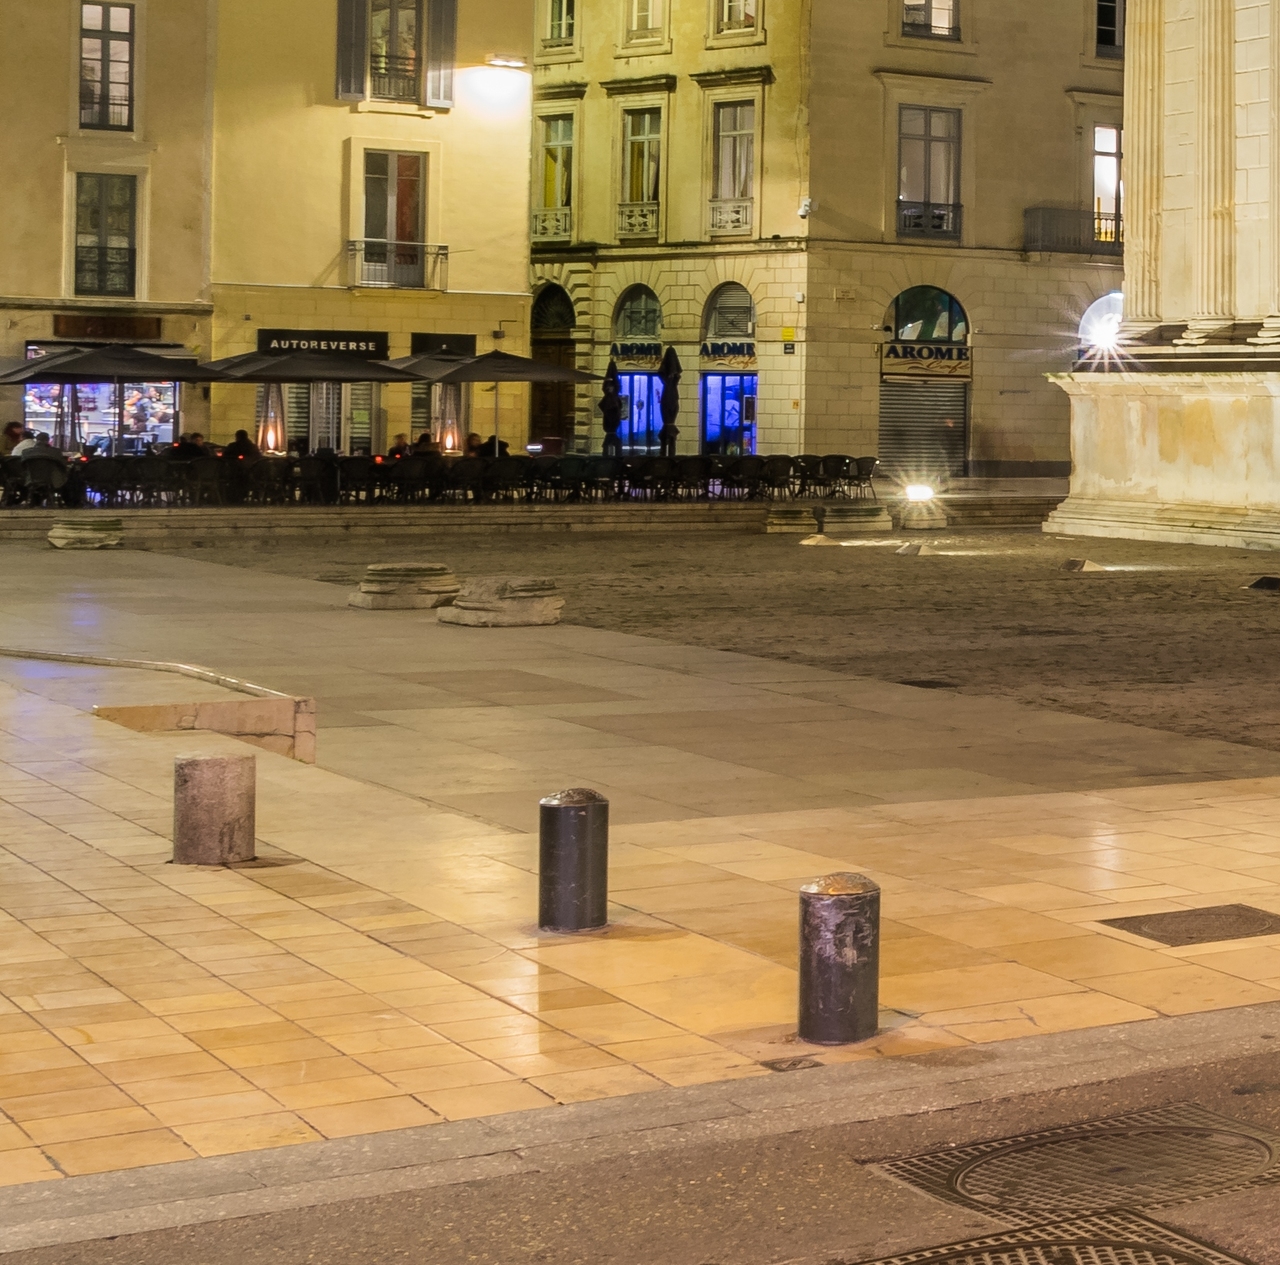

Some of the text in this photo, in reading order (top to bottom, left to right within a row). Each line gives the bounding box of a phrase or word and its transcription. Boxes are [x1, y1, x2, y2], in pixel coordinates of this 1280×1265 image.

[270, 339, 376, 351] AUTOREVERSE
[610, 342, 662, 356] AROME
[700, 341, 756, 357] AROME
[884, 345, 970, 361] AROME
